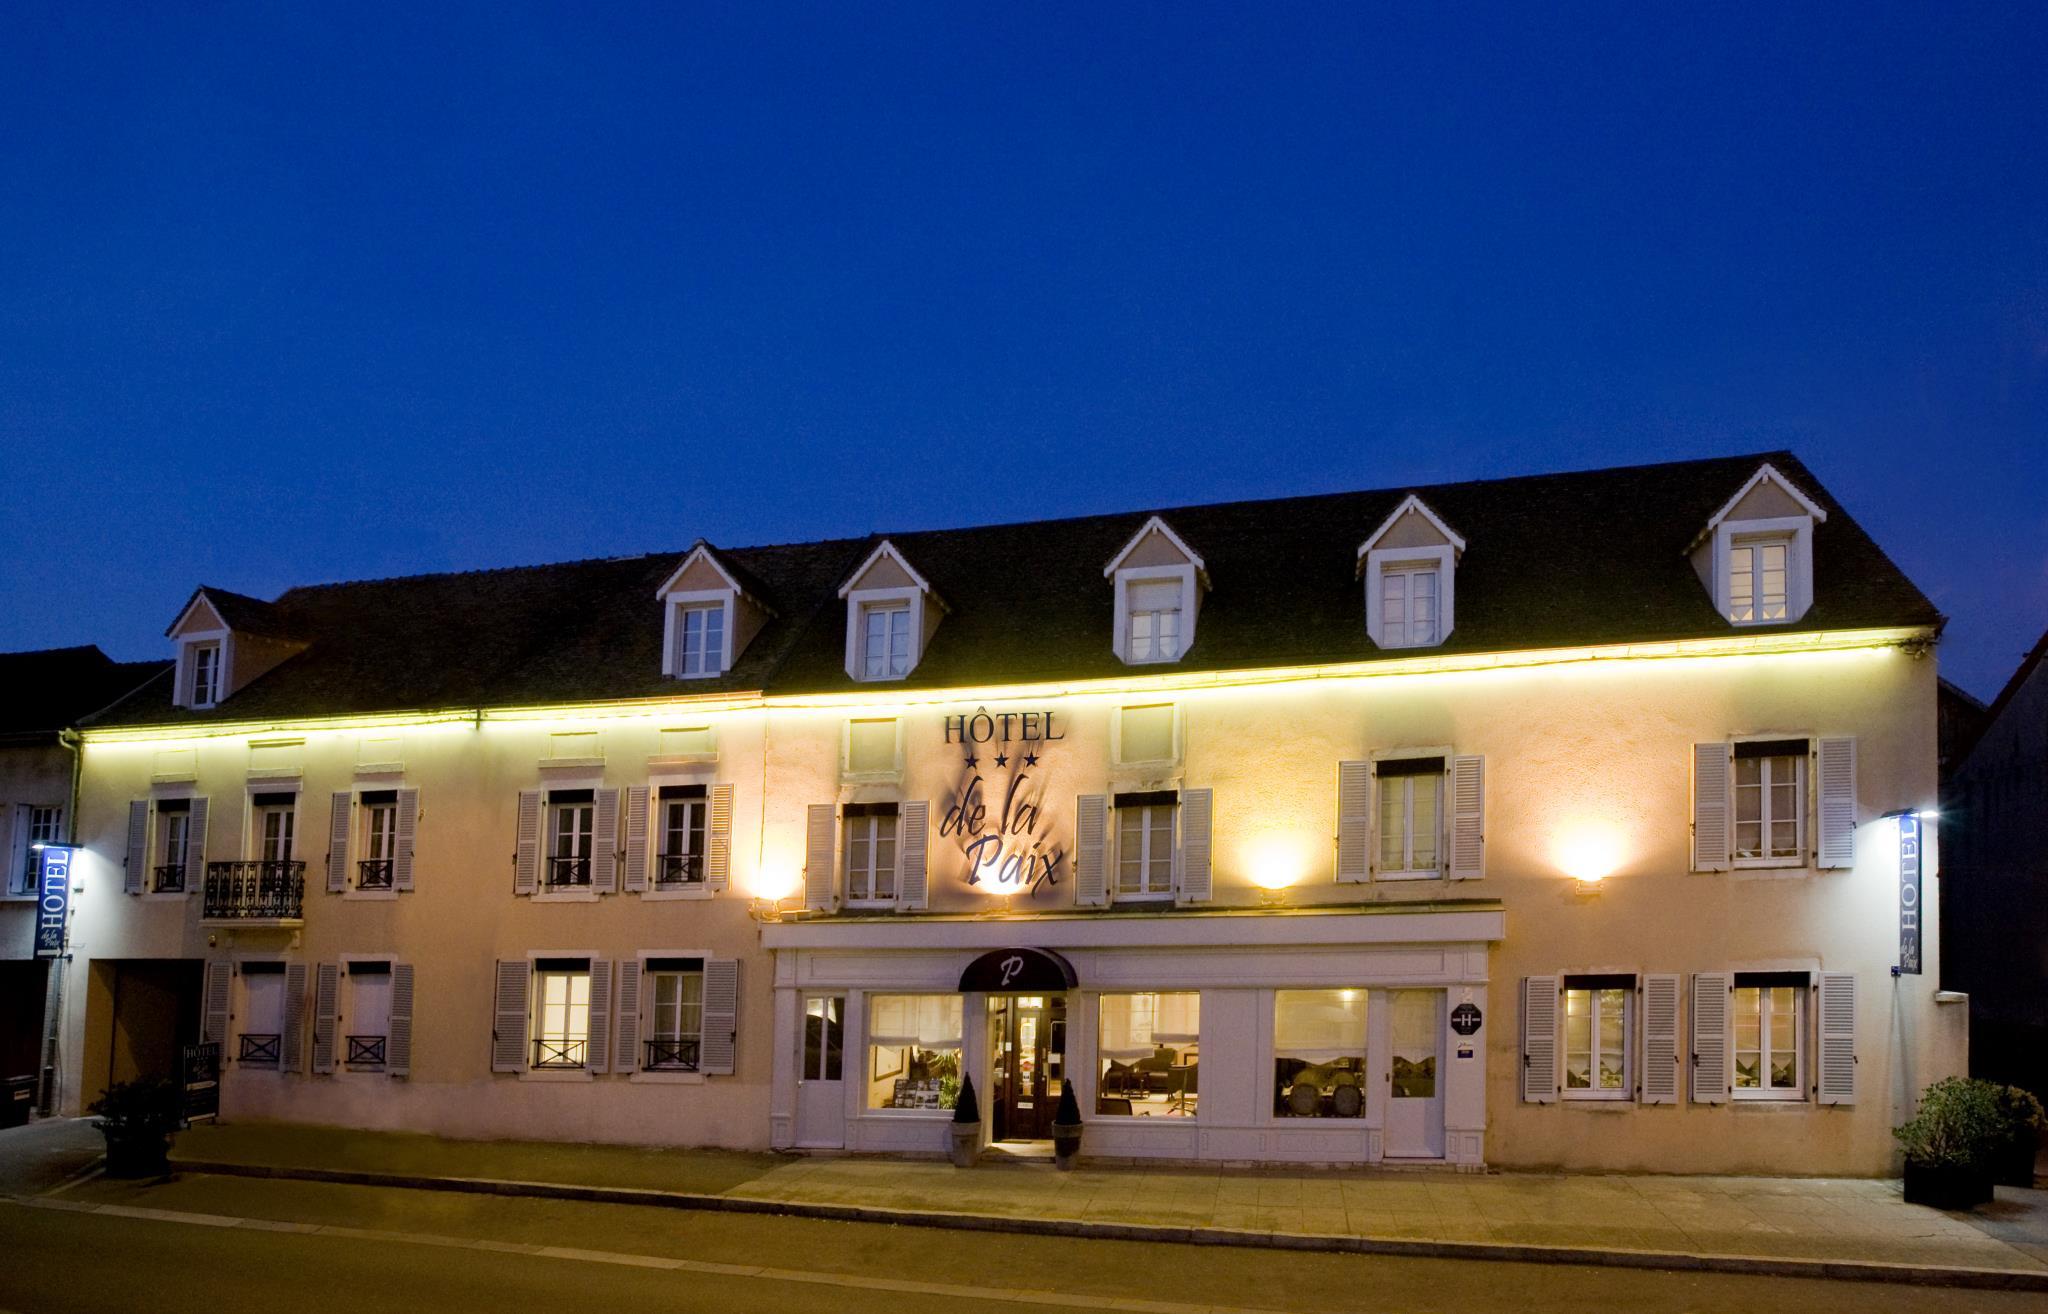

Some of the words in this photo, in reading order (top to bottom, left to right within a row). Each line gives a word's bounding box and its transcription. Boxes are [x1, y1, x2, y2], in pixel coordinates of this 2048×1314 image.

[944, 706, 1065, 744] HÔTEL
[940, 775, 986, 838] de
[1000, 773, 1038, 836] la
[41, 850, 69, 930] HOTEL
[965, 834, 1063, 899] Paix
[1901, 819, 1918, 931] HOTEL
[1000, 955, 1024, 986] P
[1461, 1014, 1472, 1027] H
